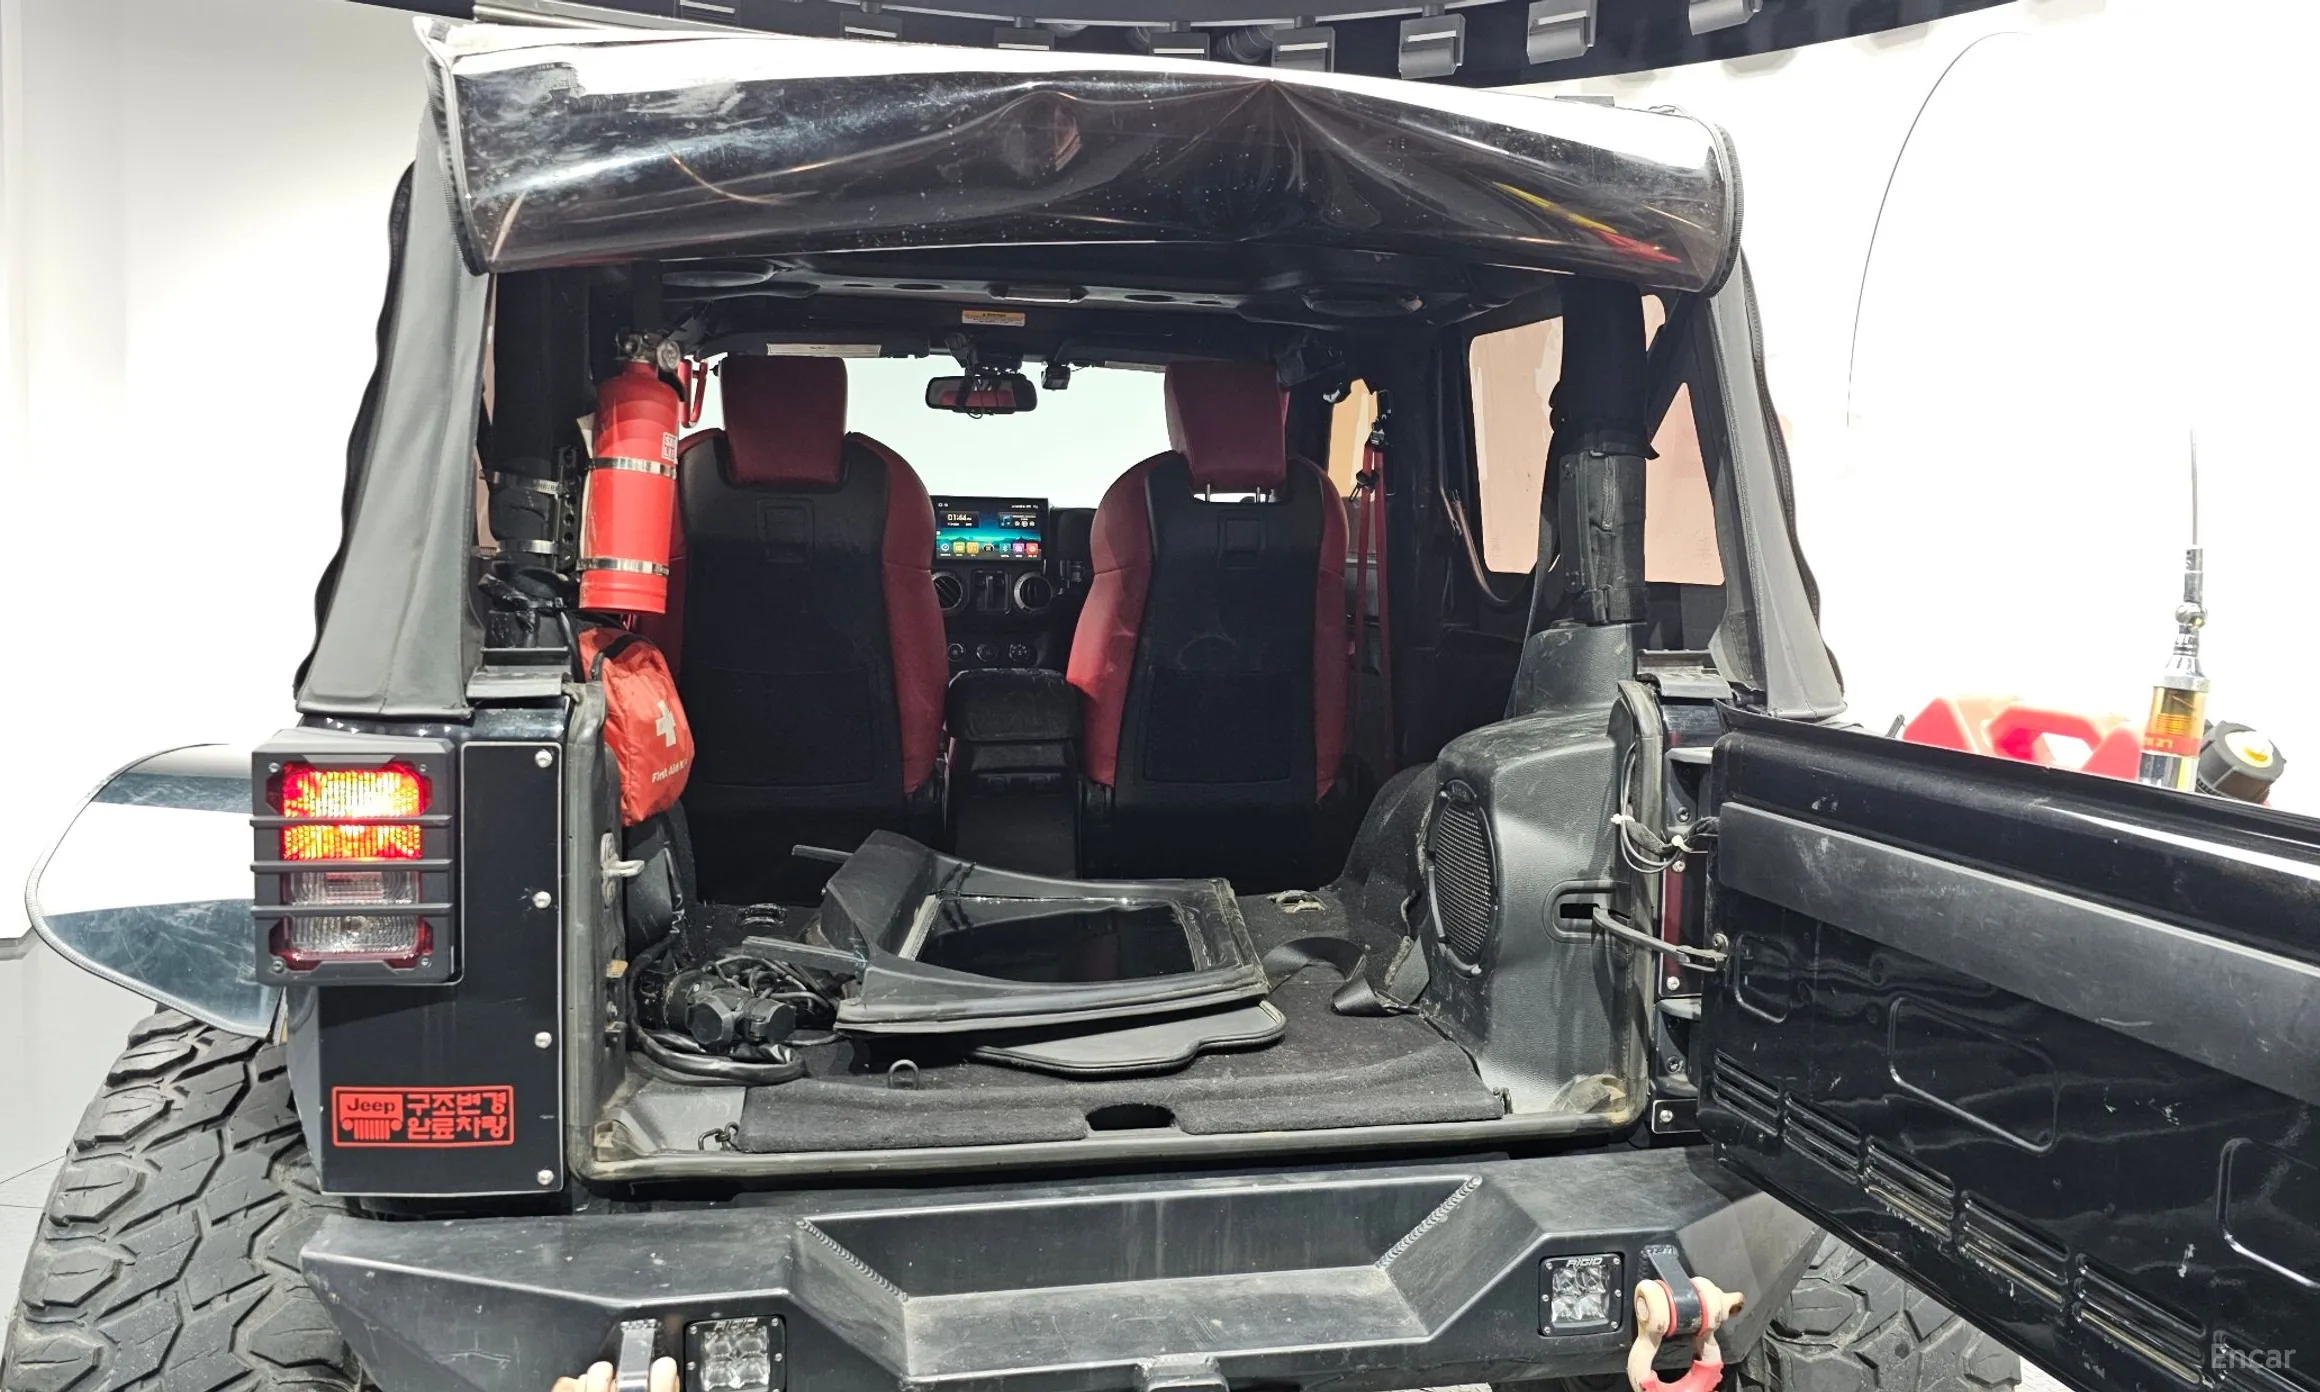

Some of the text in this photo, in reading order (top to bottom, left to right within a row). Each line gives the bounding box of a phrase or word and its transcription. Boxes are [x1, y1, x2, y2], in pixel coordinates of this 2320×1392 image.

[651, 767, 668, 783] First
[668, 762, 679, 776] Aid
[347, 1097, 396, 1114] Jeep
[407, 1091, 507, 1116] 구조변경
[407, 1116, 507, 1140] 완료차량
[1565, 1257, 1604, 1268] RIGID
